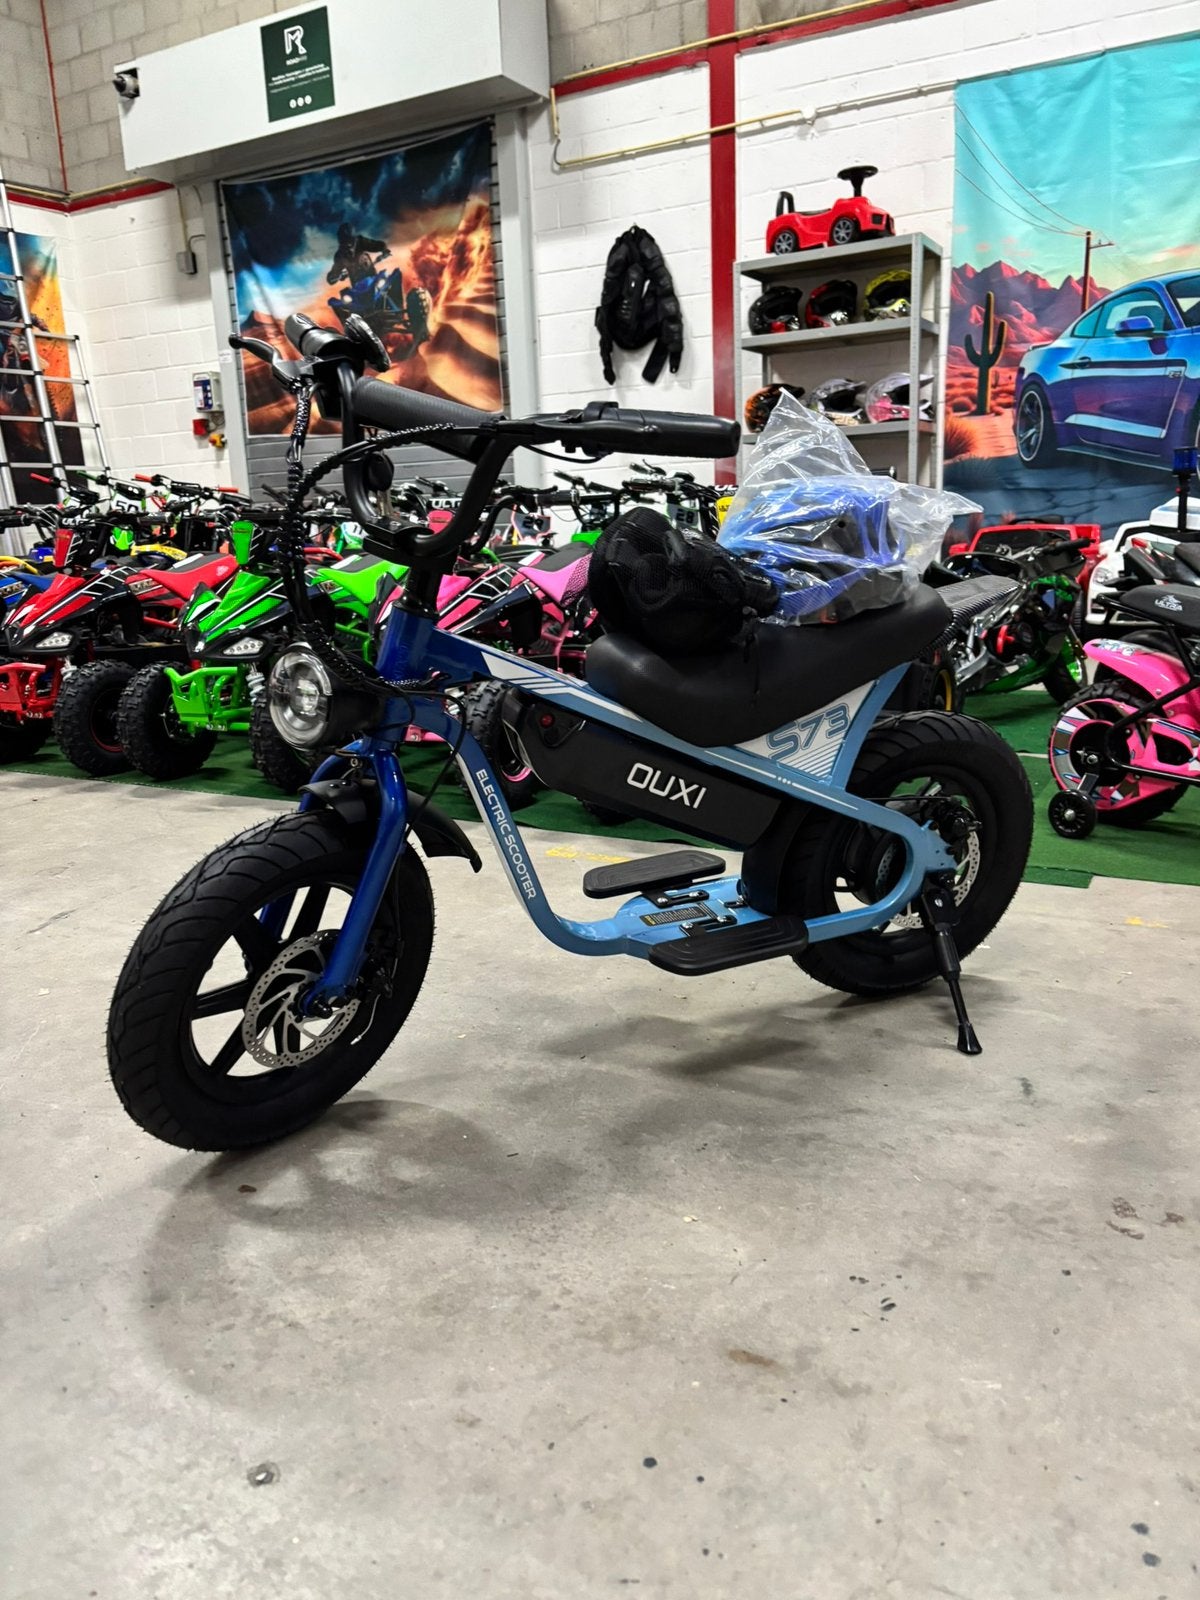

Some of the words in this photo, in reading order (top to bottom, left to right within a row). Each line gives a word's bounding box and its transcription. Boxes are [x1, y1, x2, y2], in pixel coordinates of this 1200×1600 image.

[766, 703, 850, 762] S73
[626, 762, 707, 809] OUXI
[476, 768, 511, 835] ELECTRIC
[504, 834, 537, 899] SCOOTER
